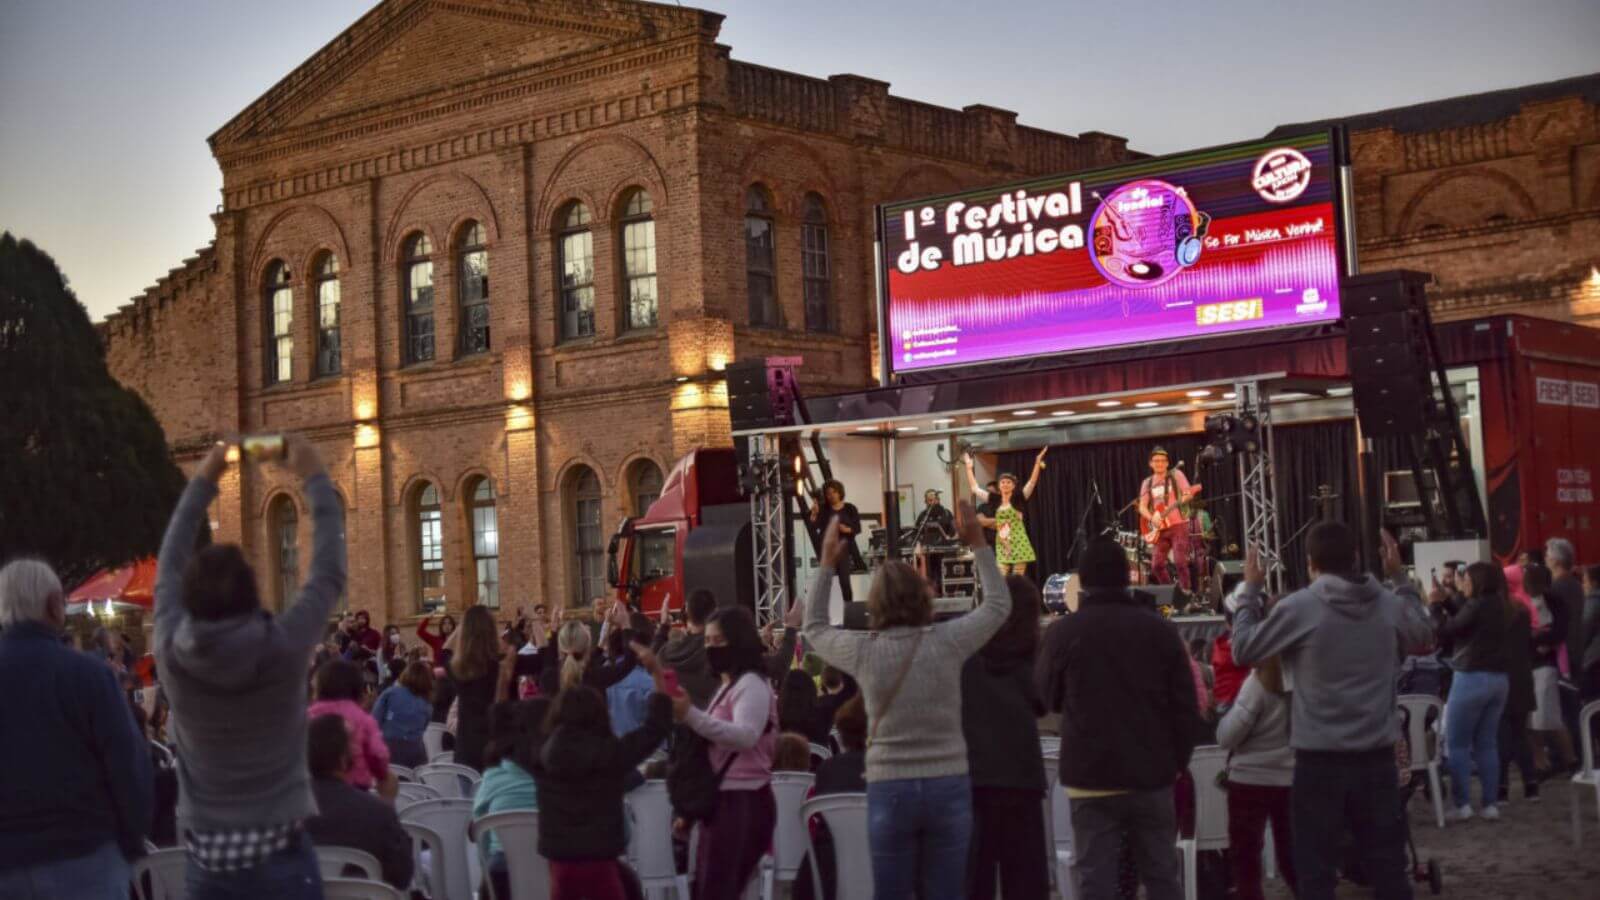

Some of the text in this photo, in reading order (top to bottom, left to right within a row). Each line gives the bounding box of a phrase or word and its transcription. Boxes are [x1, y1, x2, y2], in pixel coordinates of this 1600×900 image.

[946, 181, 1082, 234] Festival
[897, 223, 1084, 273] de Música
[1202, 300, 1257, 322] SESI
